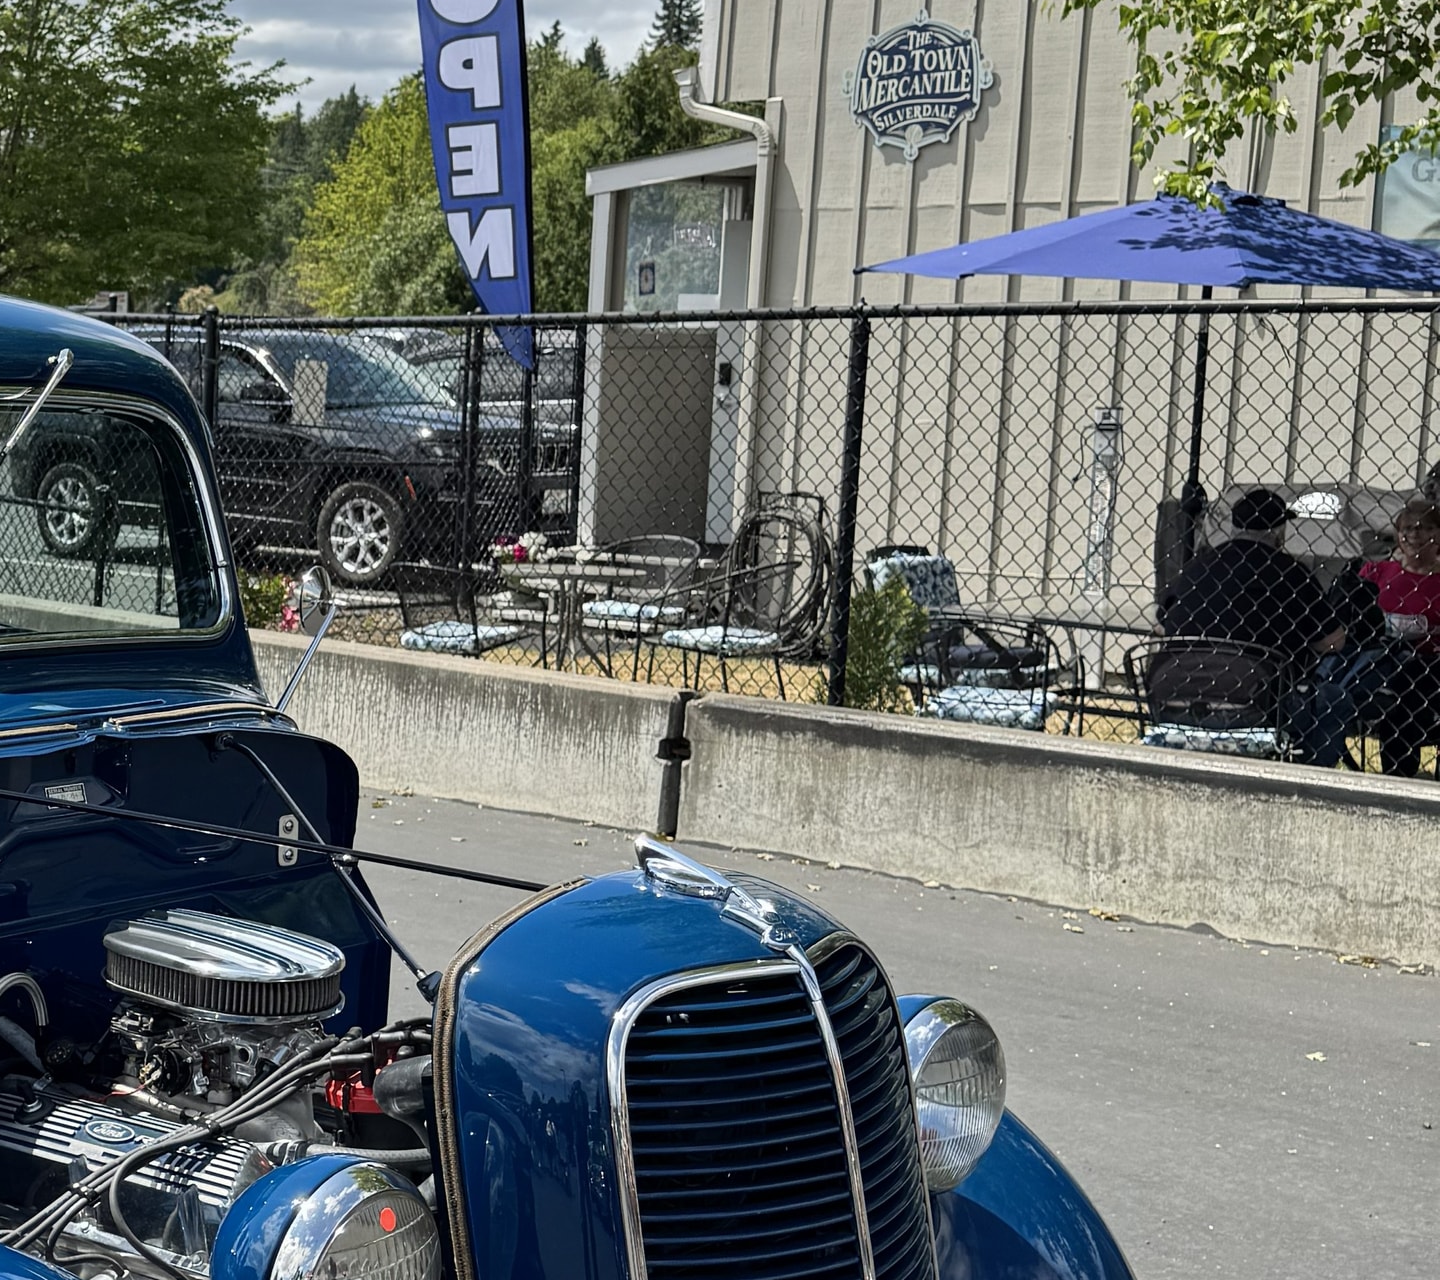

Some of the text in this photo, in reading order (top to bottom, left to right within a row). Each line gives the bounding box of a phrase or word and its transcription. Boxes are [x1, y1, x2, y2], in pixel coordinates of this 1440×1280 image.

[867, 45, 971, 78] OLD TOWN
[858, 69, 972, 113] MERCANTILE
[875, 104, 958, 131] SILVERDALE
